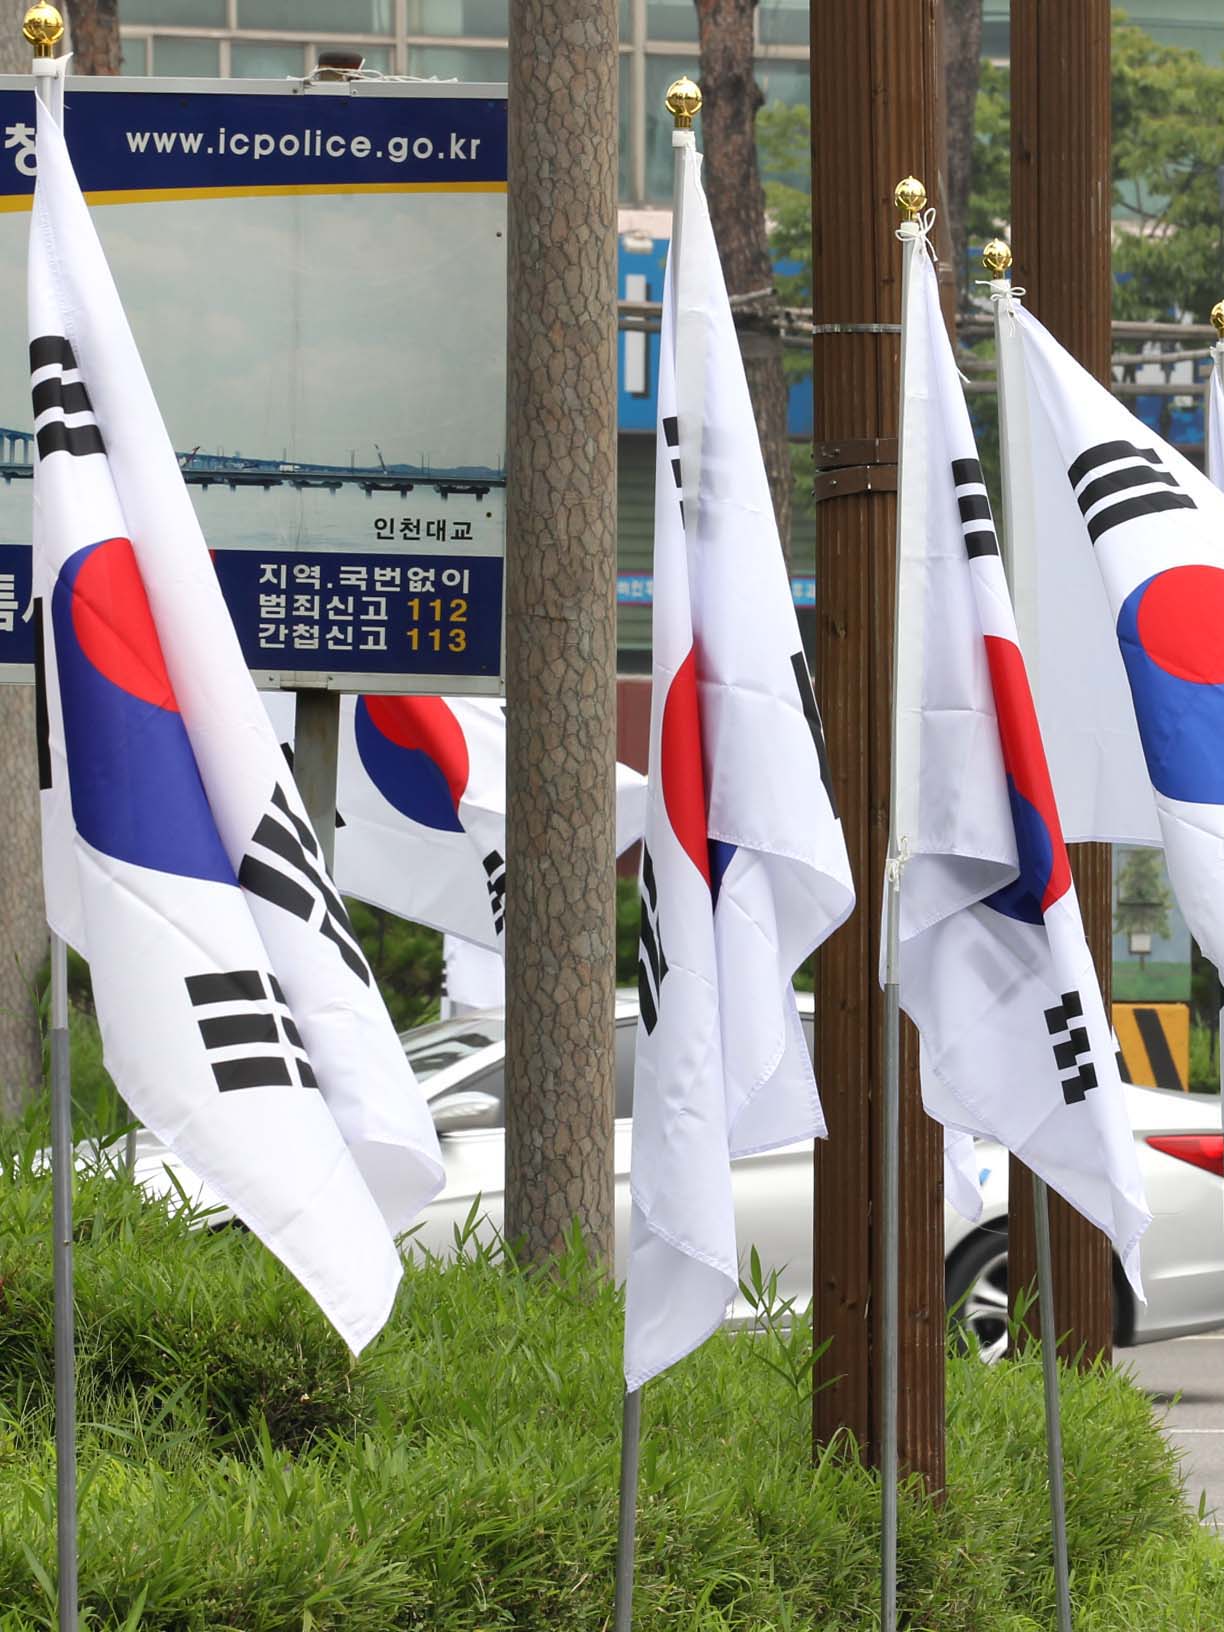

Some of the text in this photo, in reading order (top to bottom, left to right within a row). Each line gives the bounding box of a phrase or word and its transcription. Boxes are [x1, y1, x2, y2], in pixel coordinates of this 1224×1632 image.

[126, 127, 481, 163] www.icpolice.go.kr
[374, 517, 473, 542] 인천대교
[259, 594, 468, 622] 범죄신고 112
[258, 624, 467, 652] 간첩신고 113
